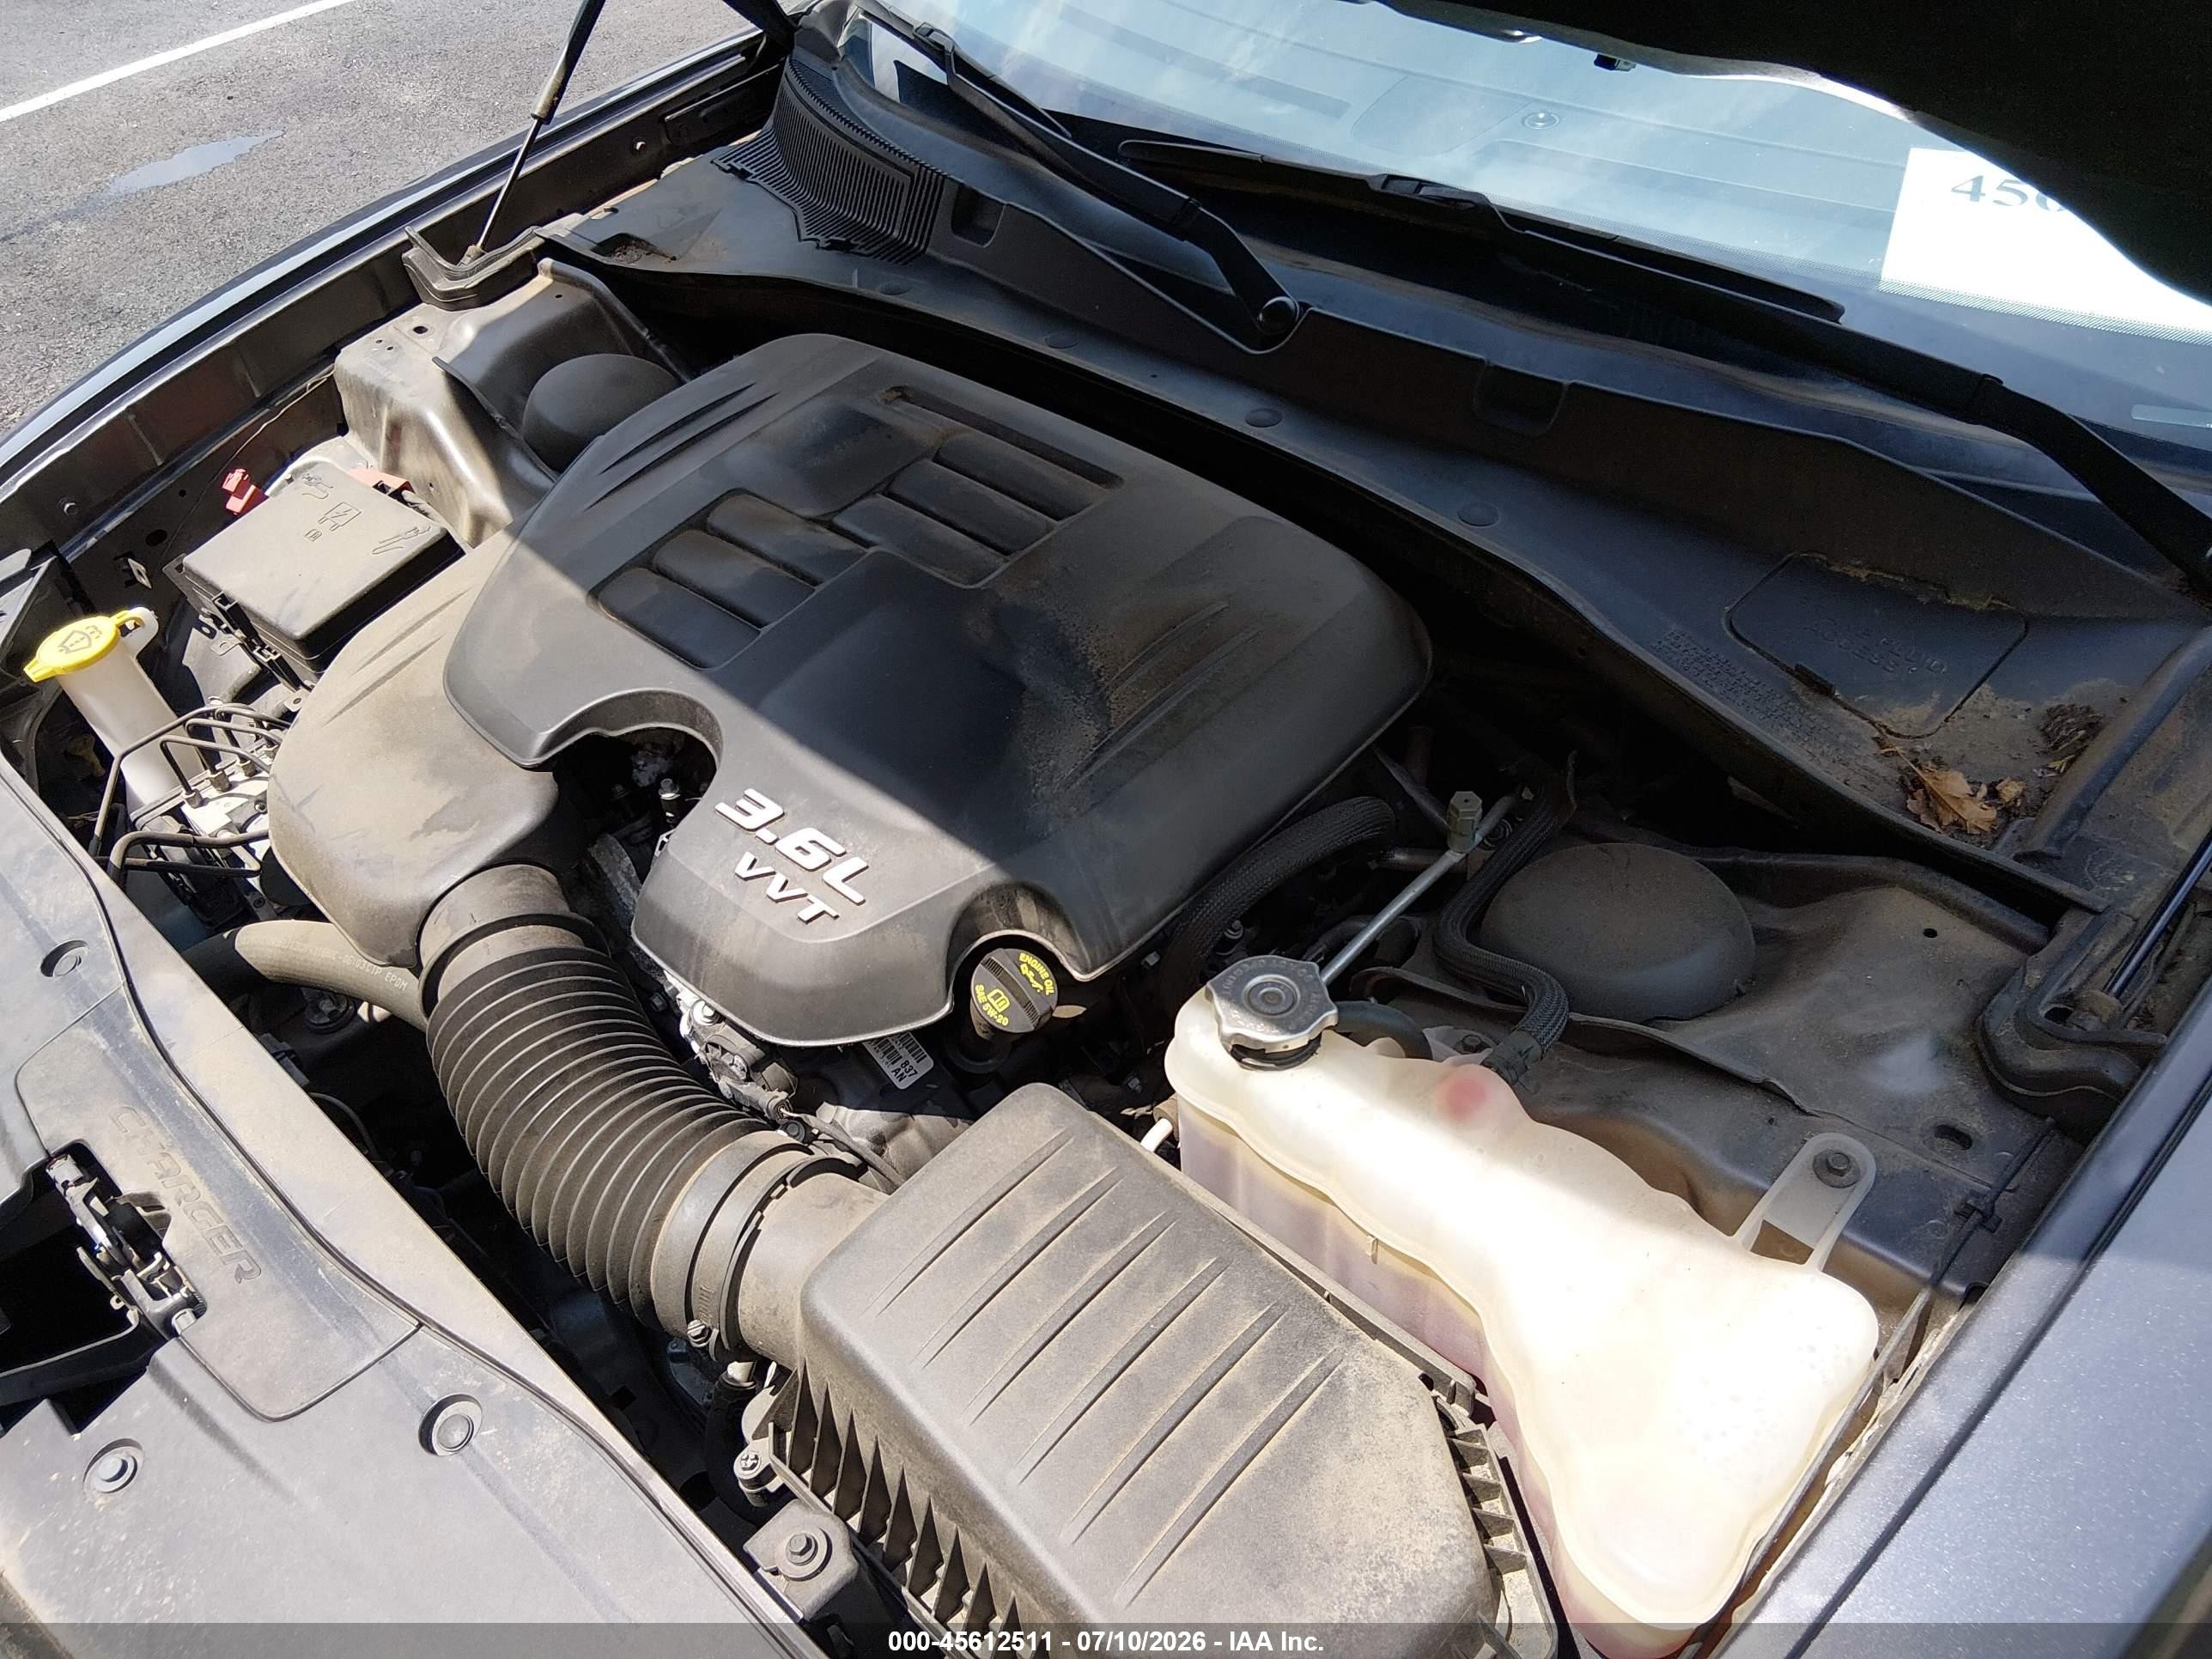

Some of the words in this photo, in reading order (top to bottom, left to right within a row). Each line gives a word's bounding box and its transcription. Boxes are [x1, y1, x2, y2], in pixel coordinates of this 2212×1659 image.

[714, 787, 870, 907] 3.6L
[734, 851, 841, 925] VVT
[384, 971, 409, 992] EPDM
[1018, 952, 1050, 980] ENGINE
[1043, 979, 1055, 996] OIL
[975, 984, 988, 1004] SAE
[981, 1002, 1010, 1027] 5W-20
[890, 1067, 908, 1083] AN
[900, 1060, 919, 1078] 837
[109, 1104, 262, 1285] CHARGER
